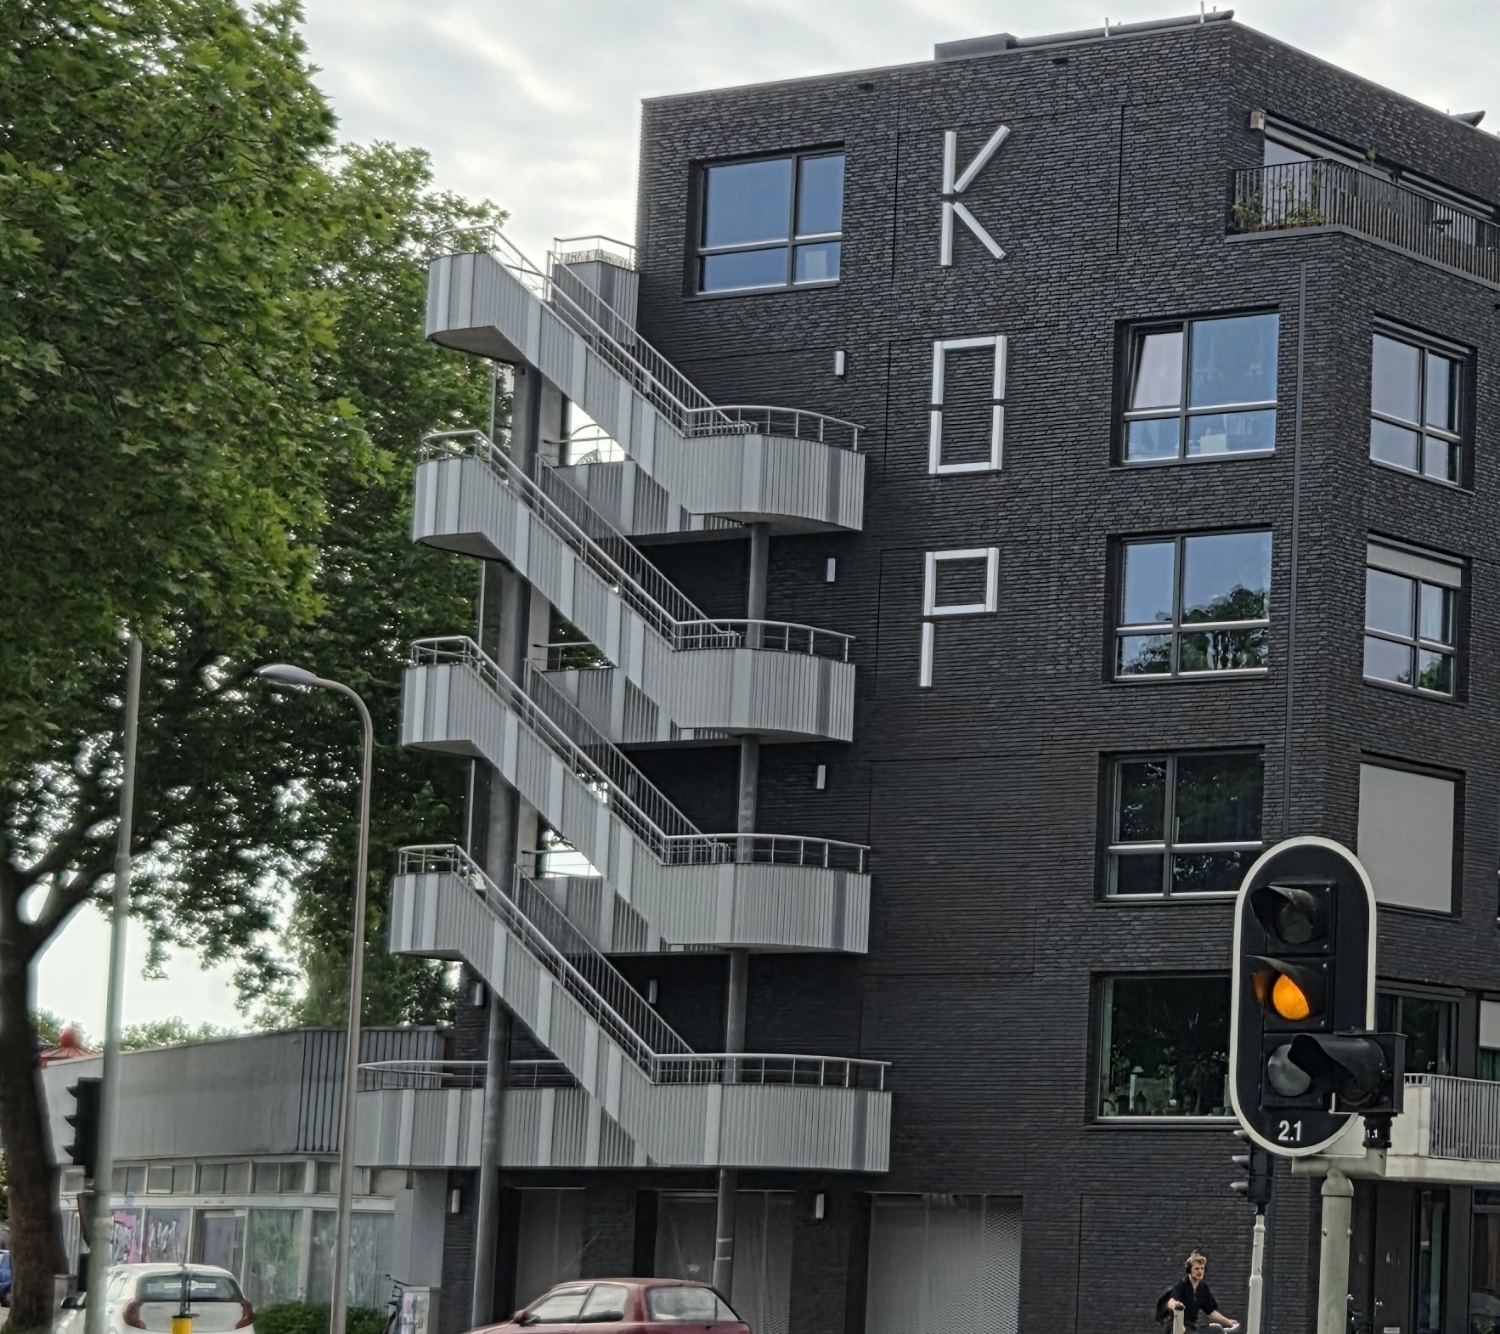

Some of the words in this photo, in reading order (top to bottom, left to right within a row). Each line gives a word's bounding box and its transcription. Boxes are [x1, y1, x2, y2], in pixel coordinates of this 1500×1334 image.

[919, 124, 1011, 687] KOP
[1278, 1120, 1302, 1141] 2.1
[1366, 1128, 1378, 1139] 1.1
